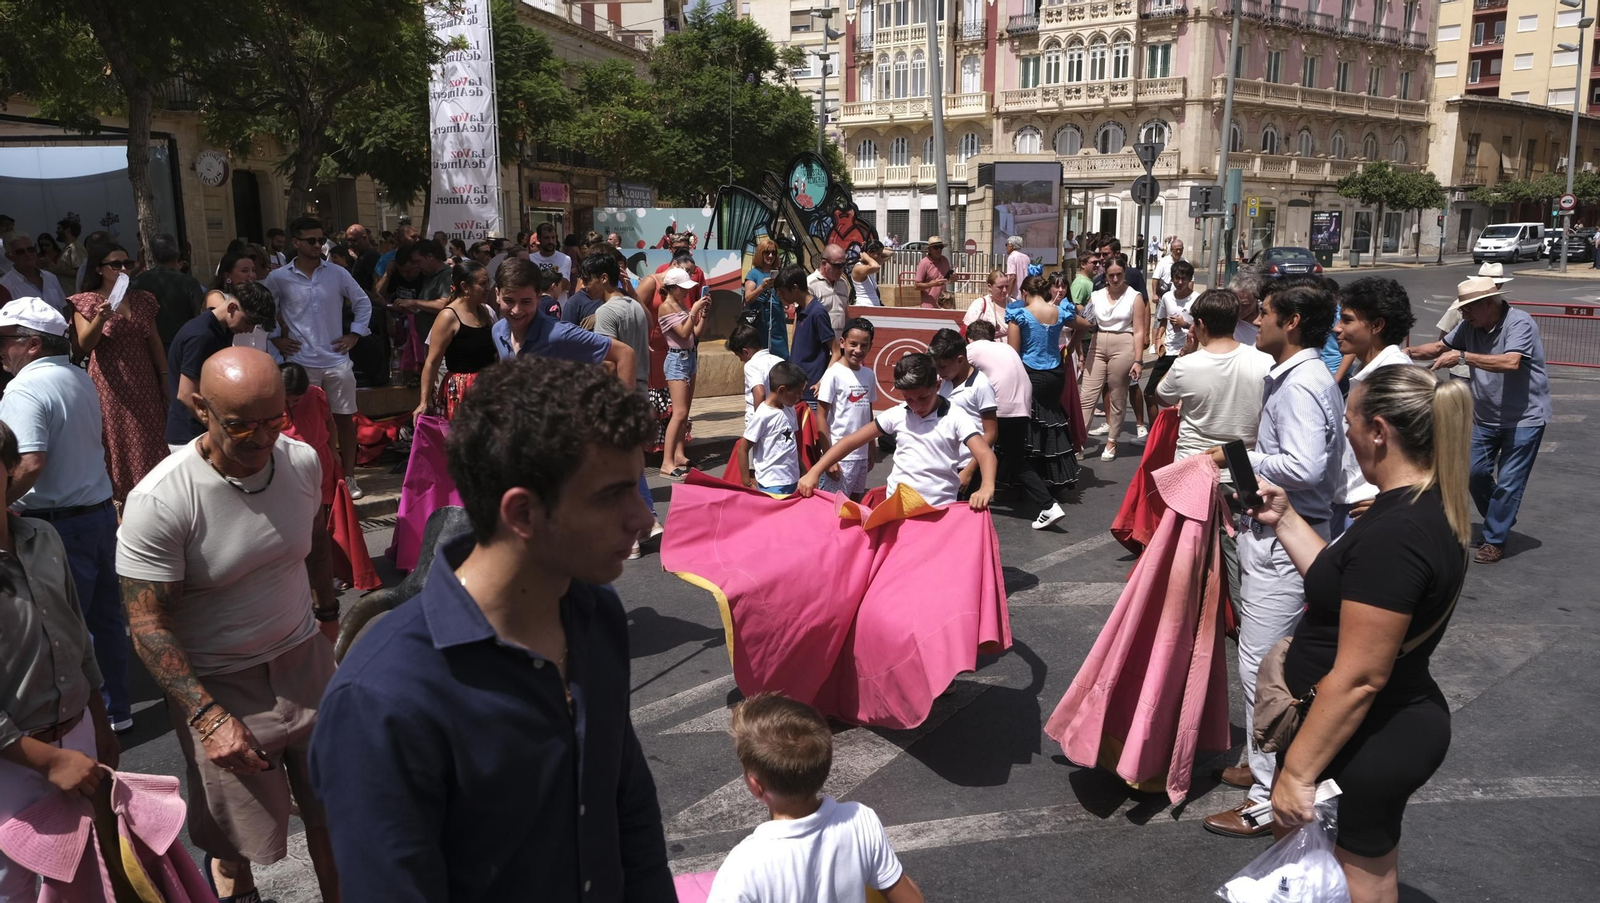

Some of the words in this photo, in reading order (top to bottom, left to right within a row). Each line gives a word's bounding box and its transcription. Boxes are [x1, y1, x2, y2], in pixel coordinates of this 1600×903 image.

[198, 171, 222, 184] ARCOS
[608, 188, 619, 197] SE
[633, 199, 641, 207] 05
[642, 200, 651, 208] 55
